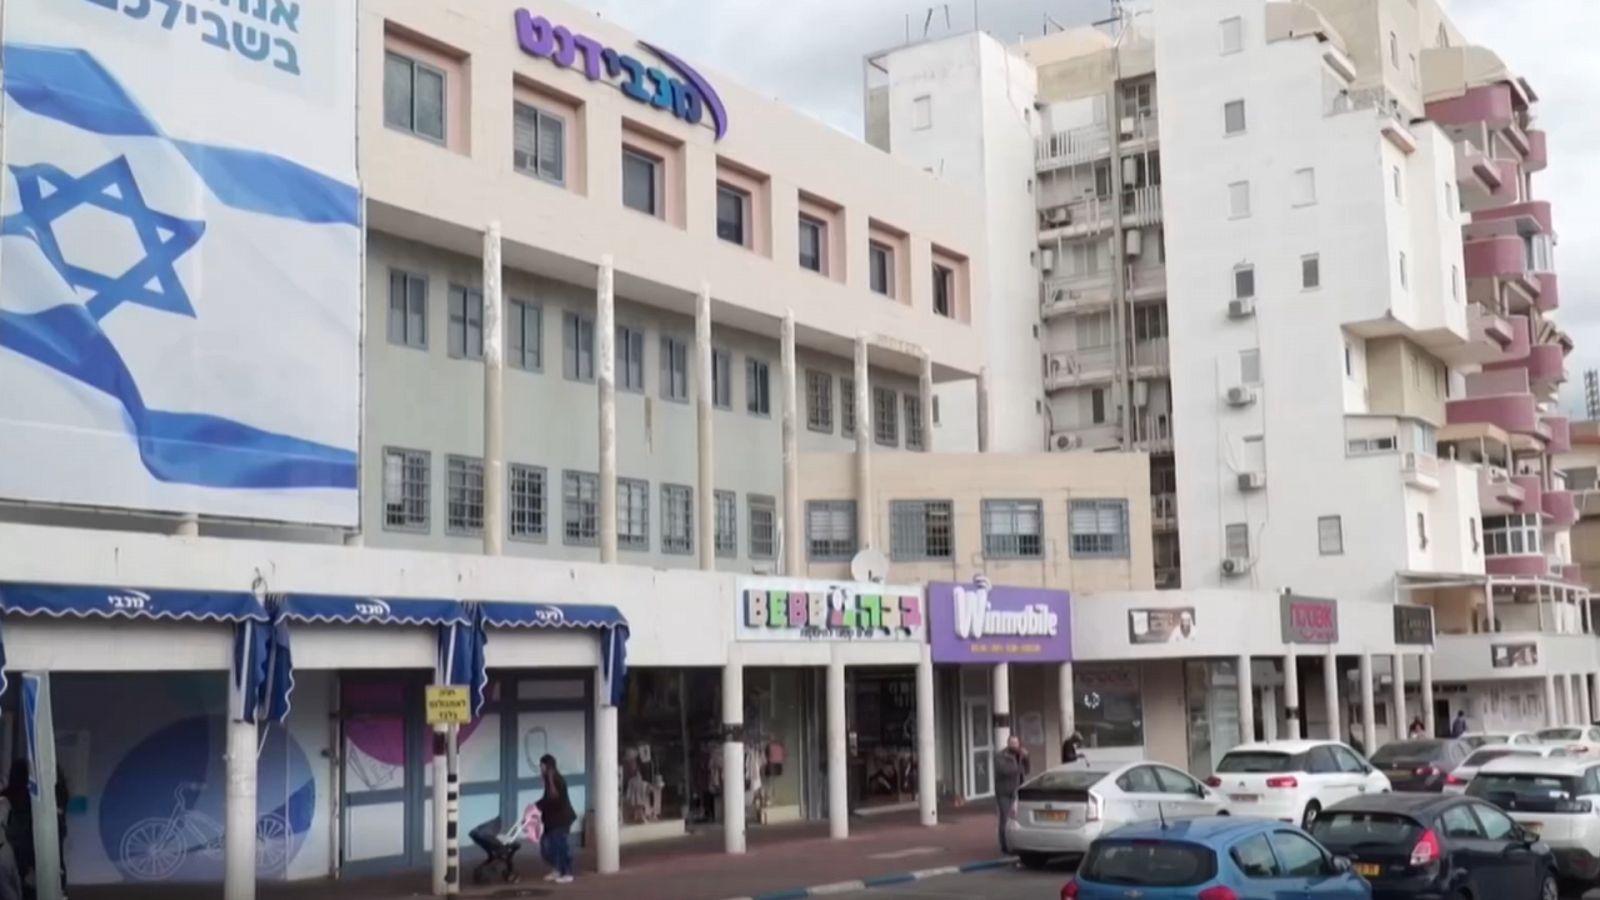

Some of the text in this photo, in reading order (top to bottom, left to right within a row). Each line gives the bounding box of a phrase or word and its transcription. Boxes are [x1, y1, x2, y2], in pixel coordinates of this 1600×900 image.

[514, 7, 703, 125] מכבידנט
[107, 595, 145, 608] מכבי
[743, 589, 826, 629] BEBE
[953, 585, 1058, 640] Winmobile
